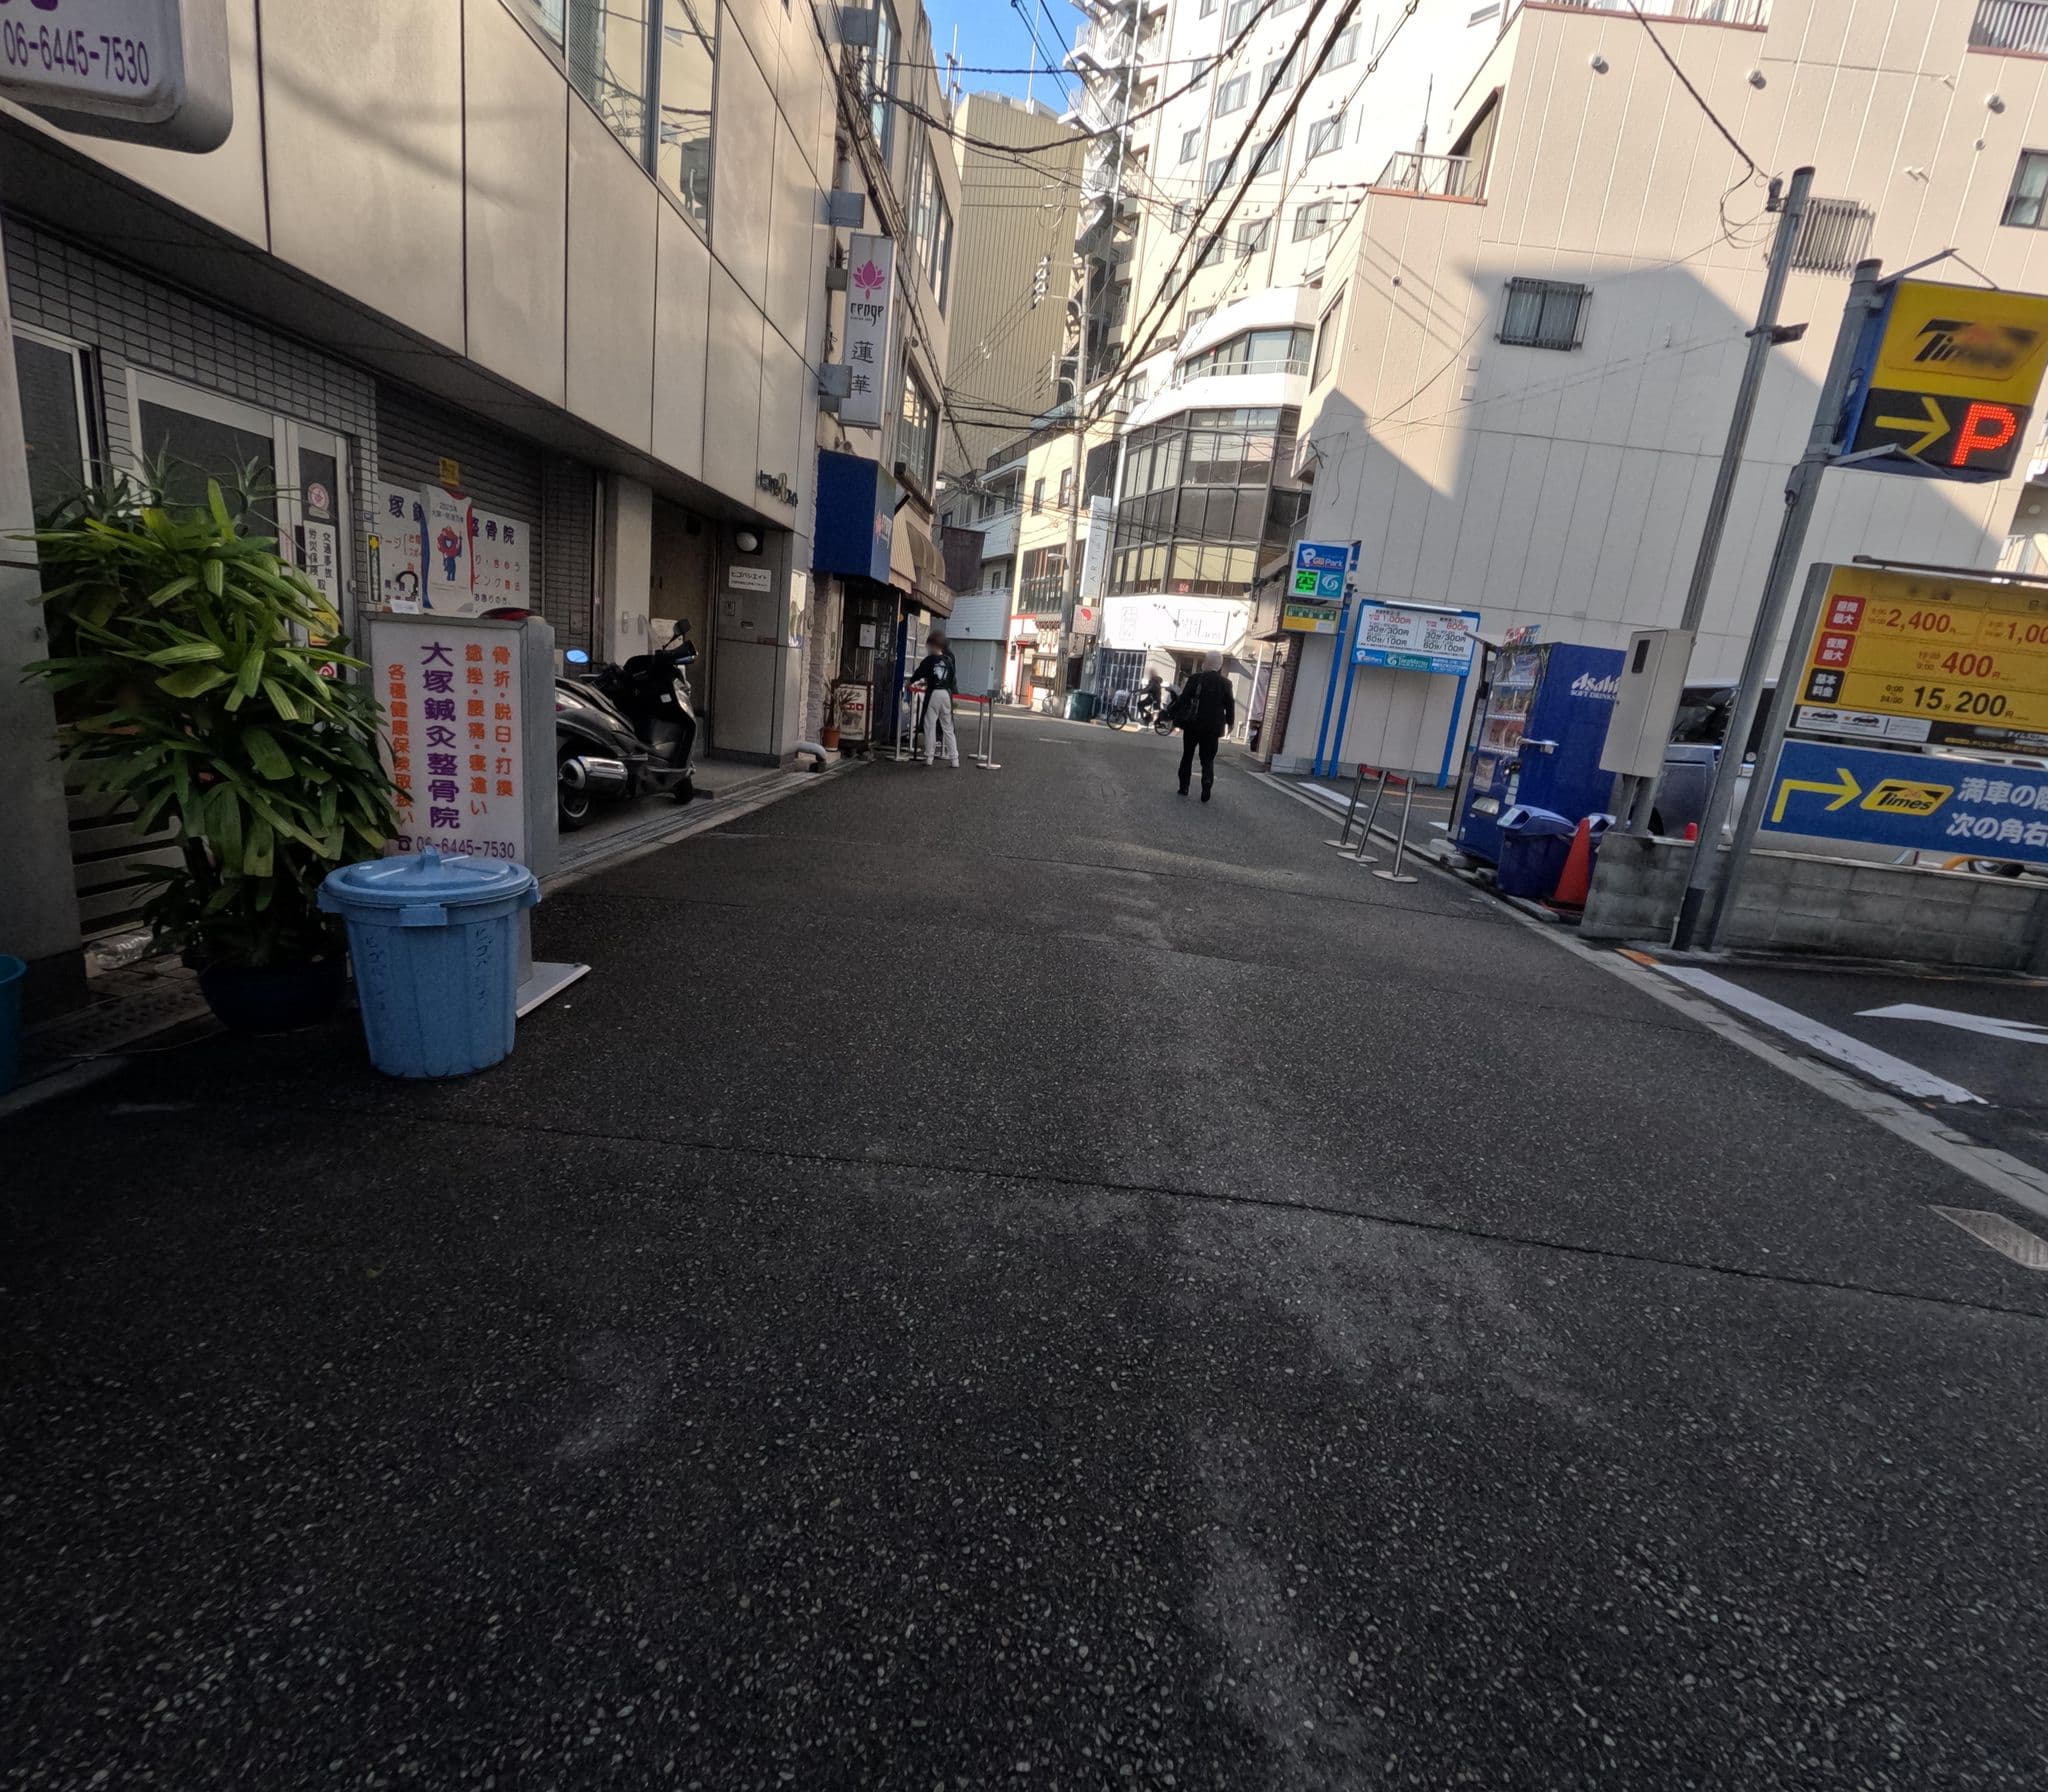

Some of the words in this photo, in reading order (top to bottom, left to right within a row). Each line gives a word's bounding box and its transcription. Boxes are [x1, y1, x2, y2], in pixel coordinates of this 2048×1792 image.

[3, 18, 150, 87] 06-6445-7530
[850, 302, 885, 327] renge
[851, 341, 875, 395] 蓮華
[1951, 402, 2017, 467] P
[1571, 672, 1621, 694] Asahi
[420, 641, 461, 829] 大塚鍼灸整骨院
[1877, 786, 1934, 812] Times
[1945, 812, 2048, 848] 次の角右
